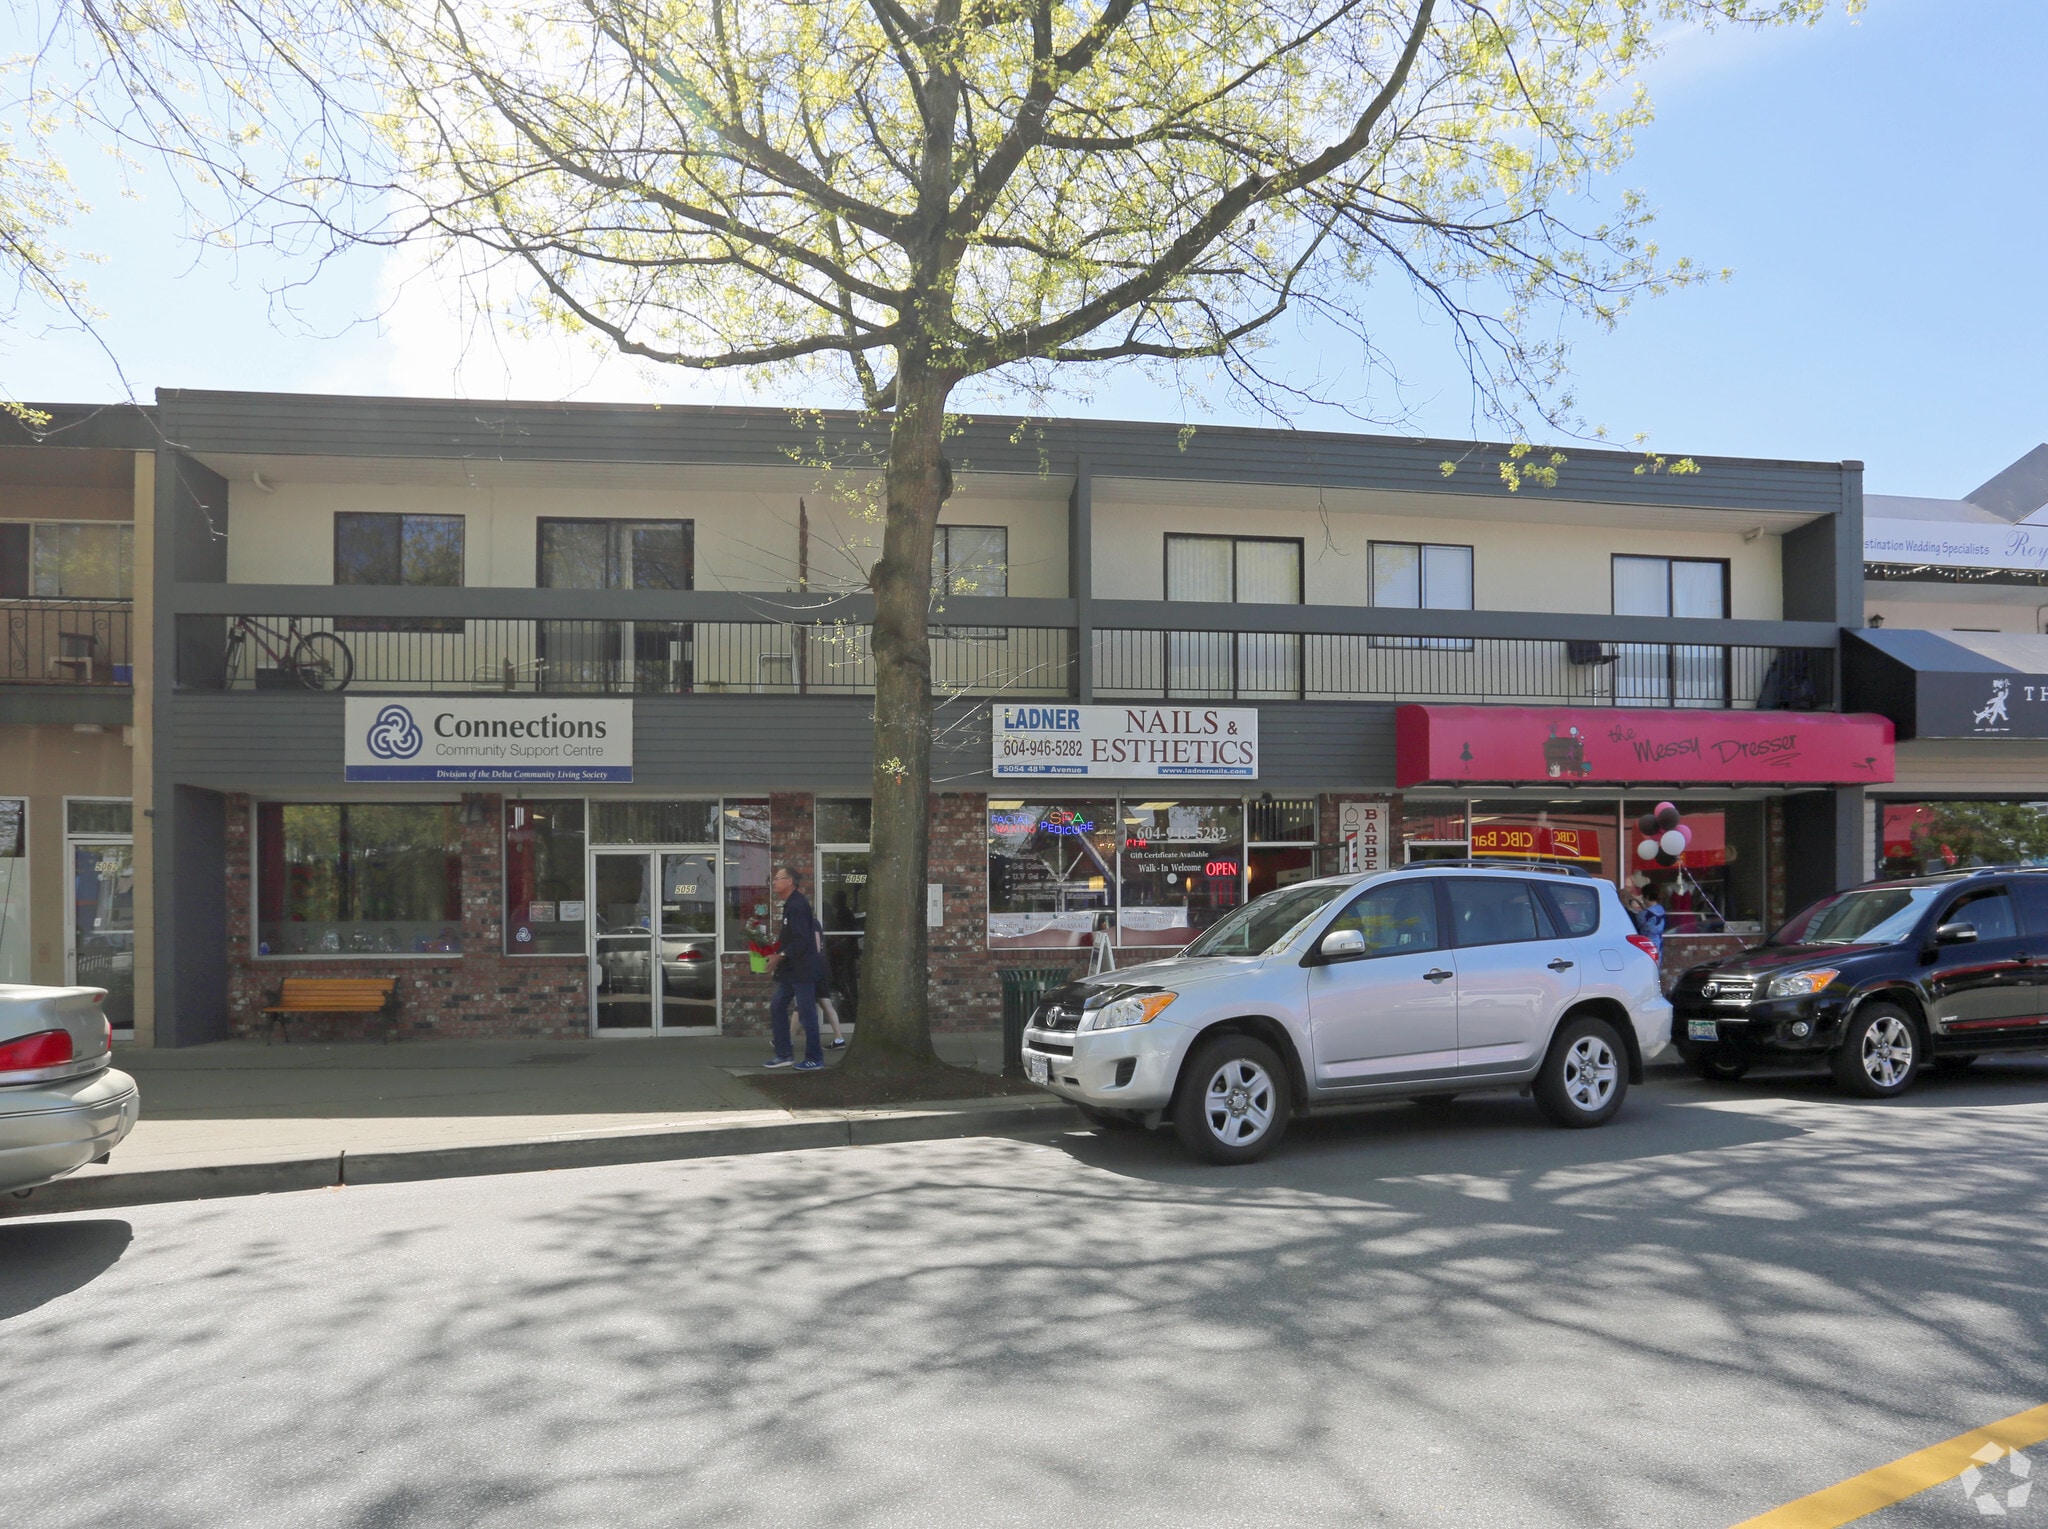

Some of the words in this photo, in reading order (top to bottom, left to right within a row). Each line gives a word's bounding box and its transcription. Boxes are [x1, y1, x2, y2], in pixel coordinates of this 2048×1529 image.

[1905, 540, 1940, 556] Wedding
[1942, 542, 1990, 557] Specialists
[434, 712, 607, 739] Connections
[1004, 708, 1080, 730] LADNER
[1124, 710, 1218, 734] NAILS
[1226, 721, 1238, 734] &
[1608, 724, 1636, 742] the
[435, 743, 506, 759] Community
[510, 743, 558, 759] Support
[562, 744, 604, 757] Centre
[1004, 739, 1082, 756] 604-946-5282
[1090, 738, 1254, 764] ESTHETICS
[1633, 736, 1702, 764] Messy
[1711, 734, 1797, 764] Dresser
[436, 770, 467, 778] Division
[468, 770, 477, 780] of
[478, 770, 490, 778] the
[492, 770, 512, 779] Delta
[514, 770, 556, 780] Community
[557, 770, 580, 780] Living
[582, 770, 608, 780] Society
[1050, 766, 1082, 774] Avenue
[991, 815, 1030, 824] FACIAL
[1049, 812, 1084, 824] SPA
[995, 824, 1036, 834] WAXING
[1040, 822, 1094, 834] PEDICURE
[1171, 863, 1202, 872] Welcome
[1206, 862, 1236, 876] OPEN
[846, 875, 866, 884] 5056
[676, 885, 696, 894] 5058
